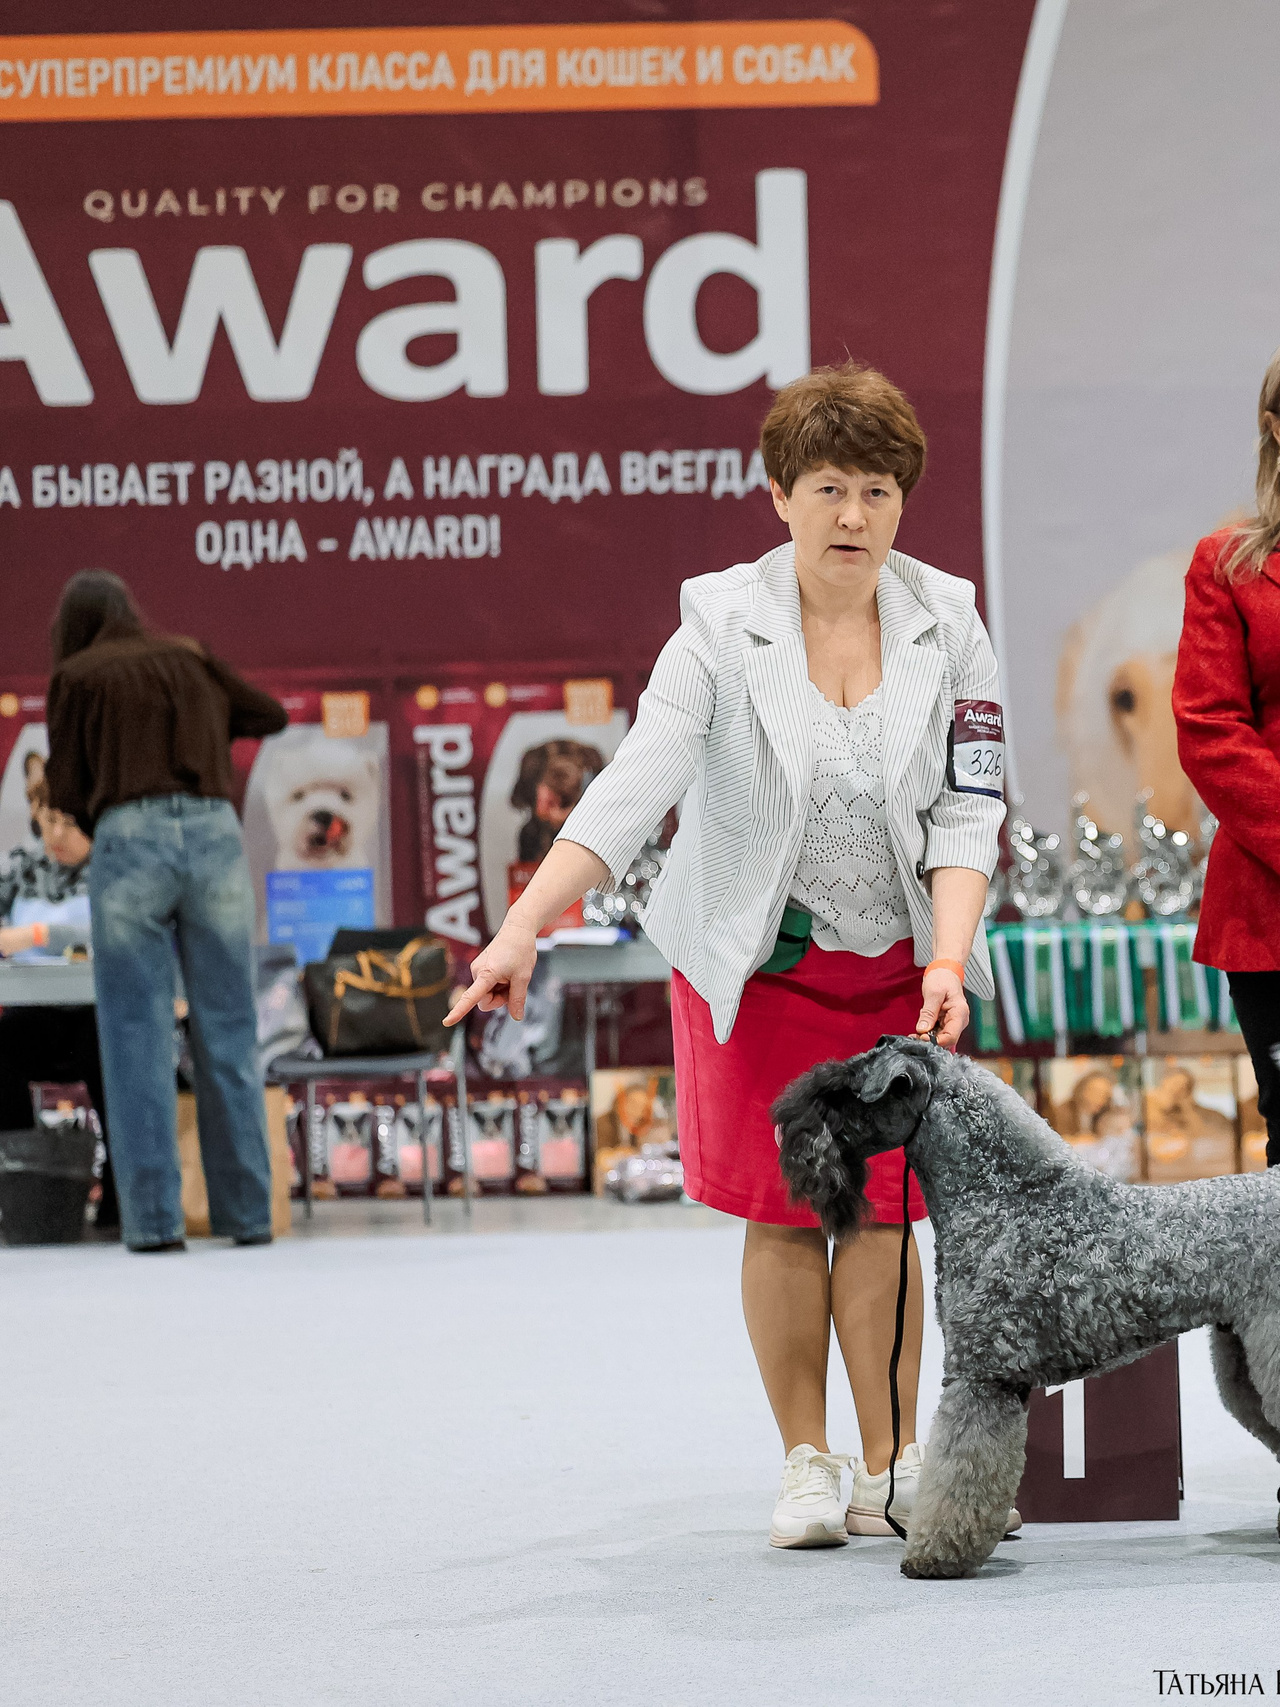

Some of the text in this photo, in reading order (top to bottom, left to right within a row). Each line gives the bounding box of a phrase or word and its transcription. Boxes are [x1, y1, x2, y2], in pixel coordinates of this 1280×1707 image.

[0, 44, 857, 99] СУПЕРПРЕМИУМ КЛАССА ДЛЯ КОШЕК И СОБАК
[84, 178, 708, 222] QUALITY FOR CHAMPIONS
[32, 462, 195, 508] БЫВАЕТ
[204, 448, 374, 506] РАЗНОЙ,
[384, 458, 414, 501] А
[423, 452, 611, 503] НАГРАДА
[196, 519, 307, 571] ОДНА
[349, 514, 501, 561] AWARD!
[968, 749, 1002, 776] 326
[413, 723, 481, 945] Award
[1045, 1378, 1086, 1479] 1
